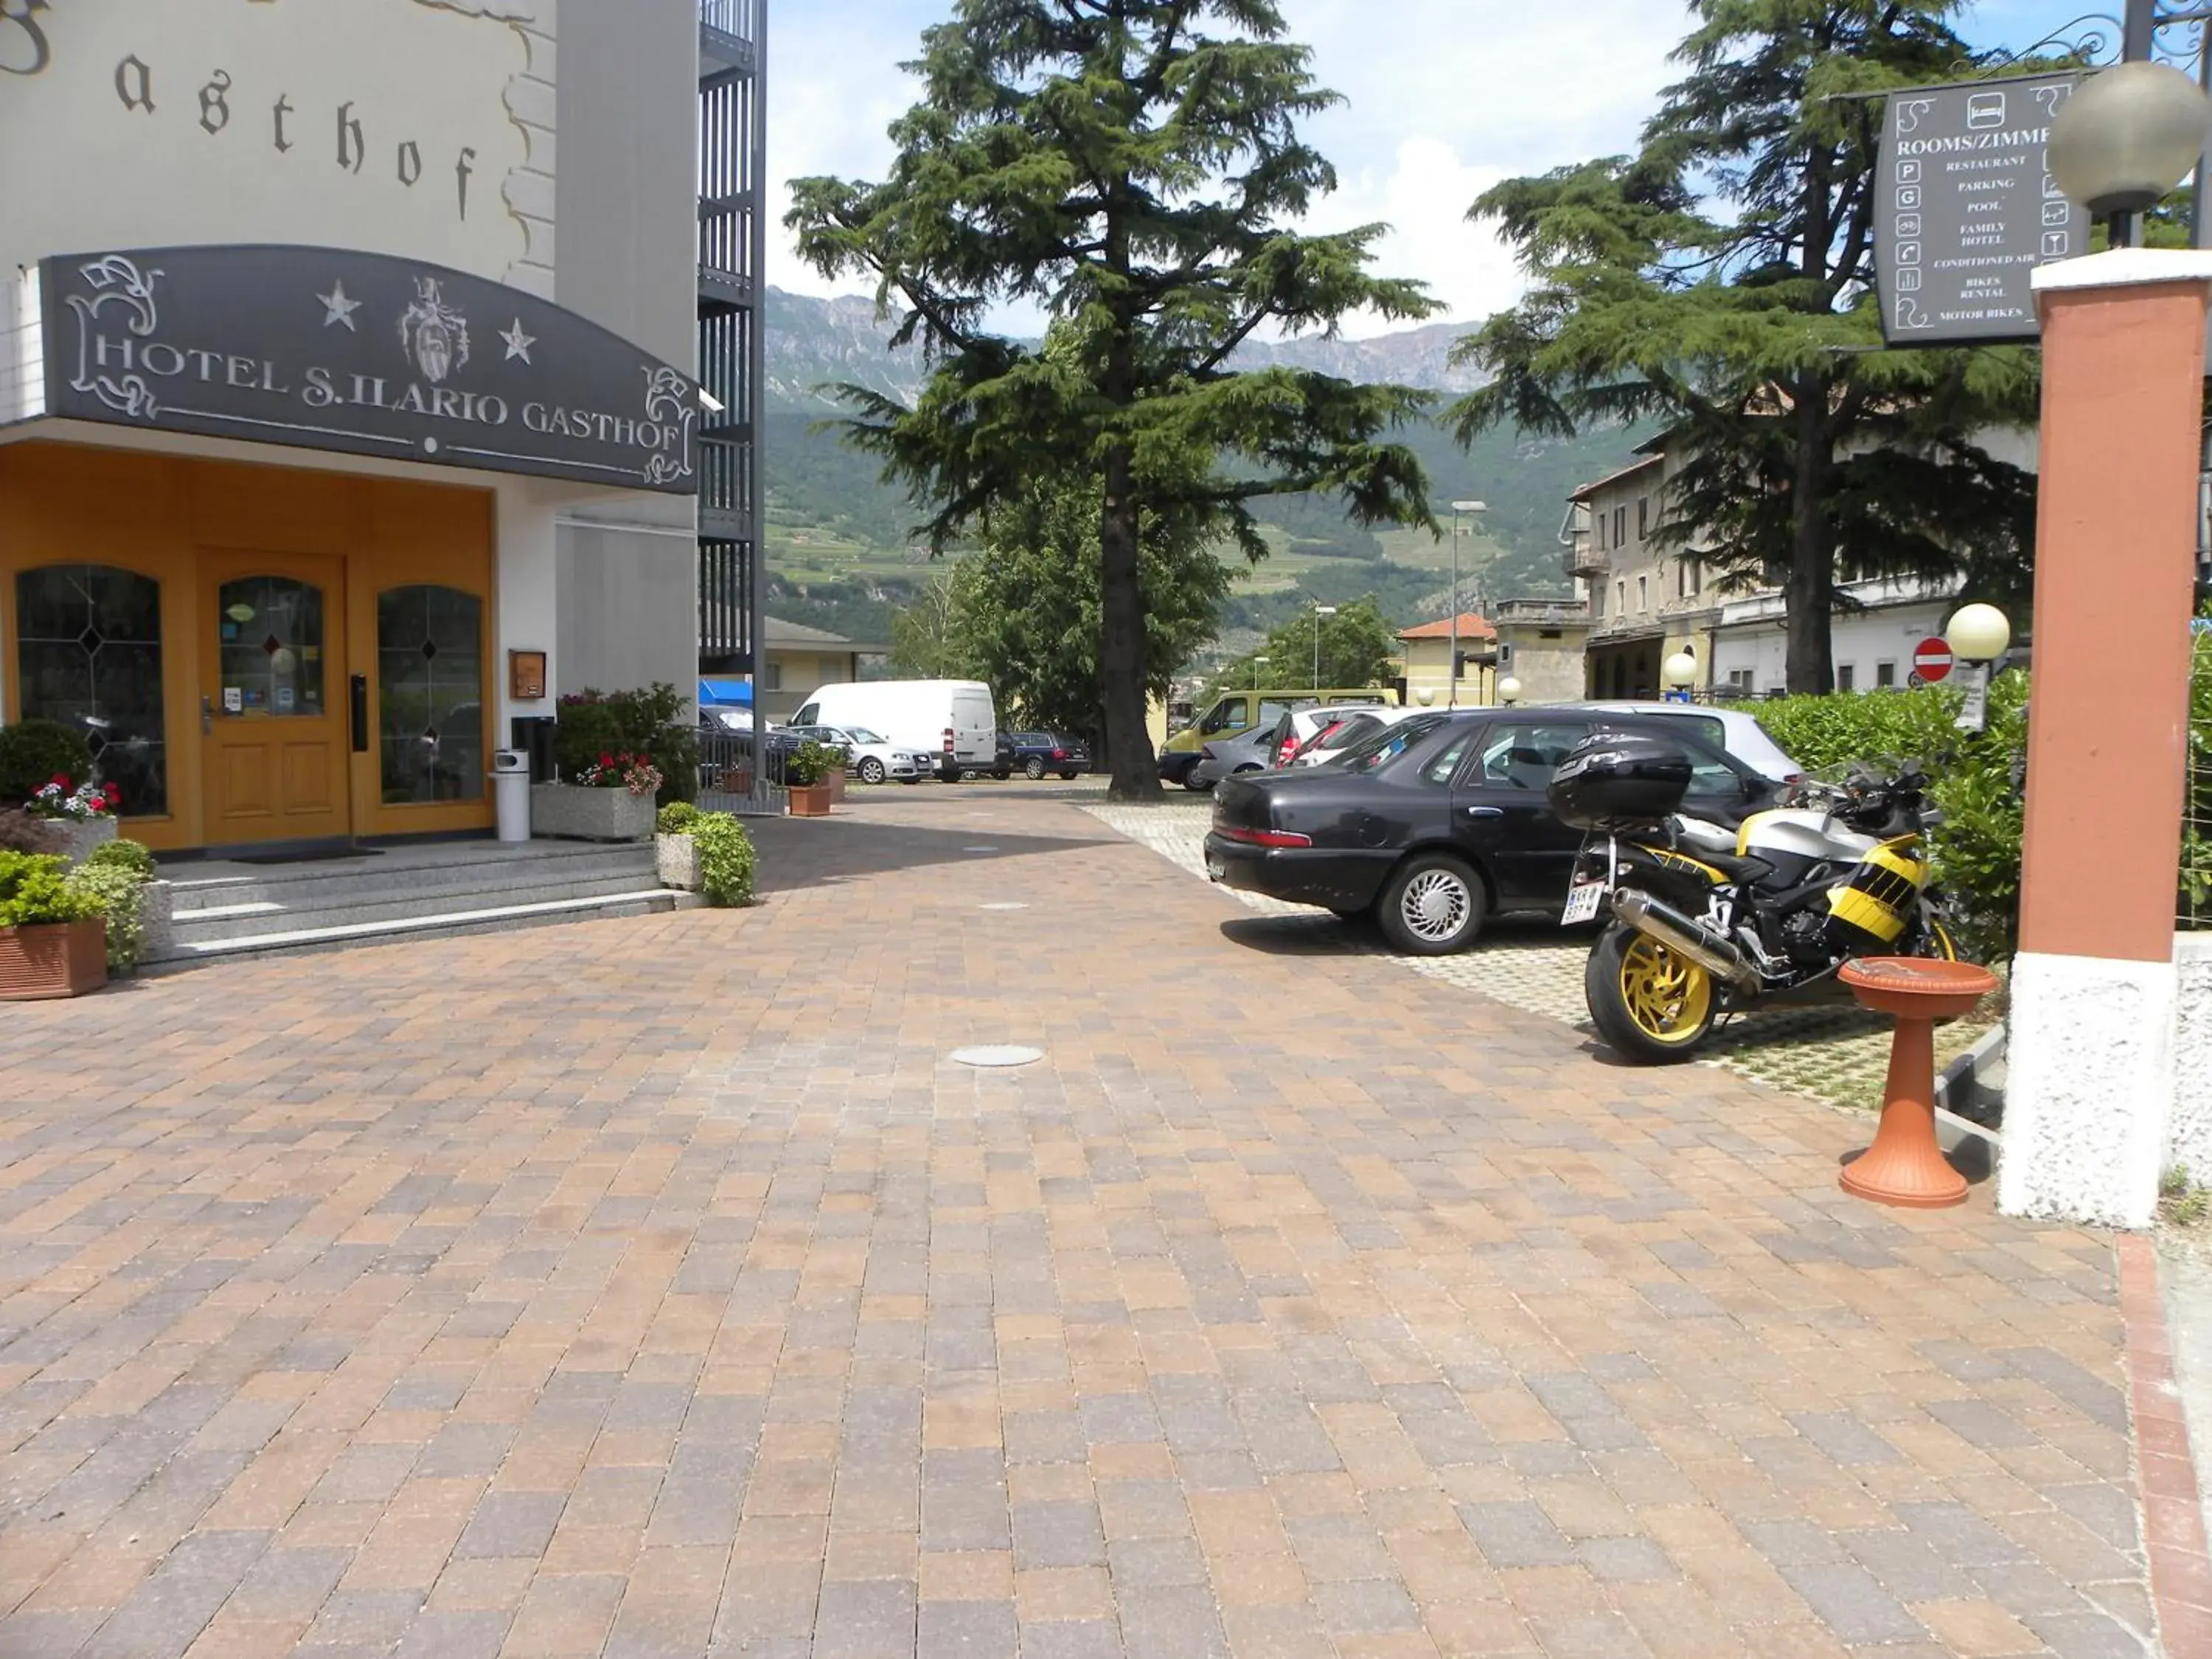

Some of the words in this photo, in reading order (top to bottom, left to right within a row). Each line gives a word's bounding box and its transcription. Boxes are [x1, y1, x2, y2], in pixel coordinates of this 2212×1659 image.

[1946, 156, 2026, 172] RESTAURANT
[1958, 178, 2015, 192] PARKING
[1966, 201, 2003, 213] POOL
[1960, 222, 2006, 234] FAMILY
[1961, 234, 2005, 247] HOTEL
[1933, 256, 2016, 269] CONDITIONED
[2017, 254, 2036, 264] AIR
[1966, 276, 2001, 288] BIKES
[1960, 288, 2007, 299] RENTAL
[1939, 310, 1983, 321] MOTOR
[1986, 307, 2023, 319] BIKES
[96, 333, 290, 394] HOTEL
[522, 401, 679, 451] GASTHOF
